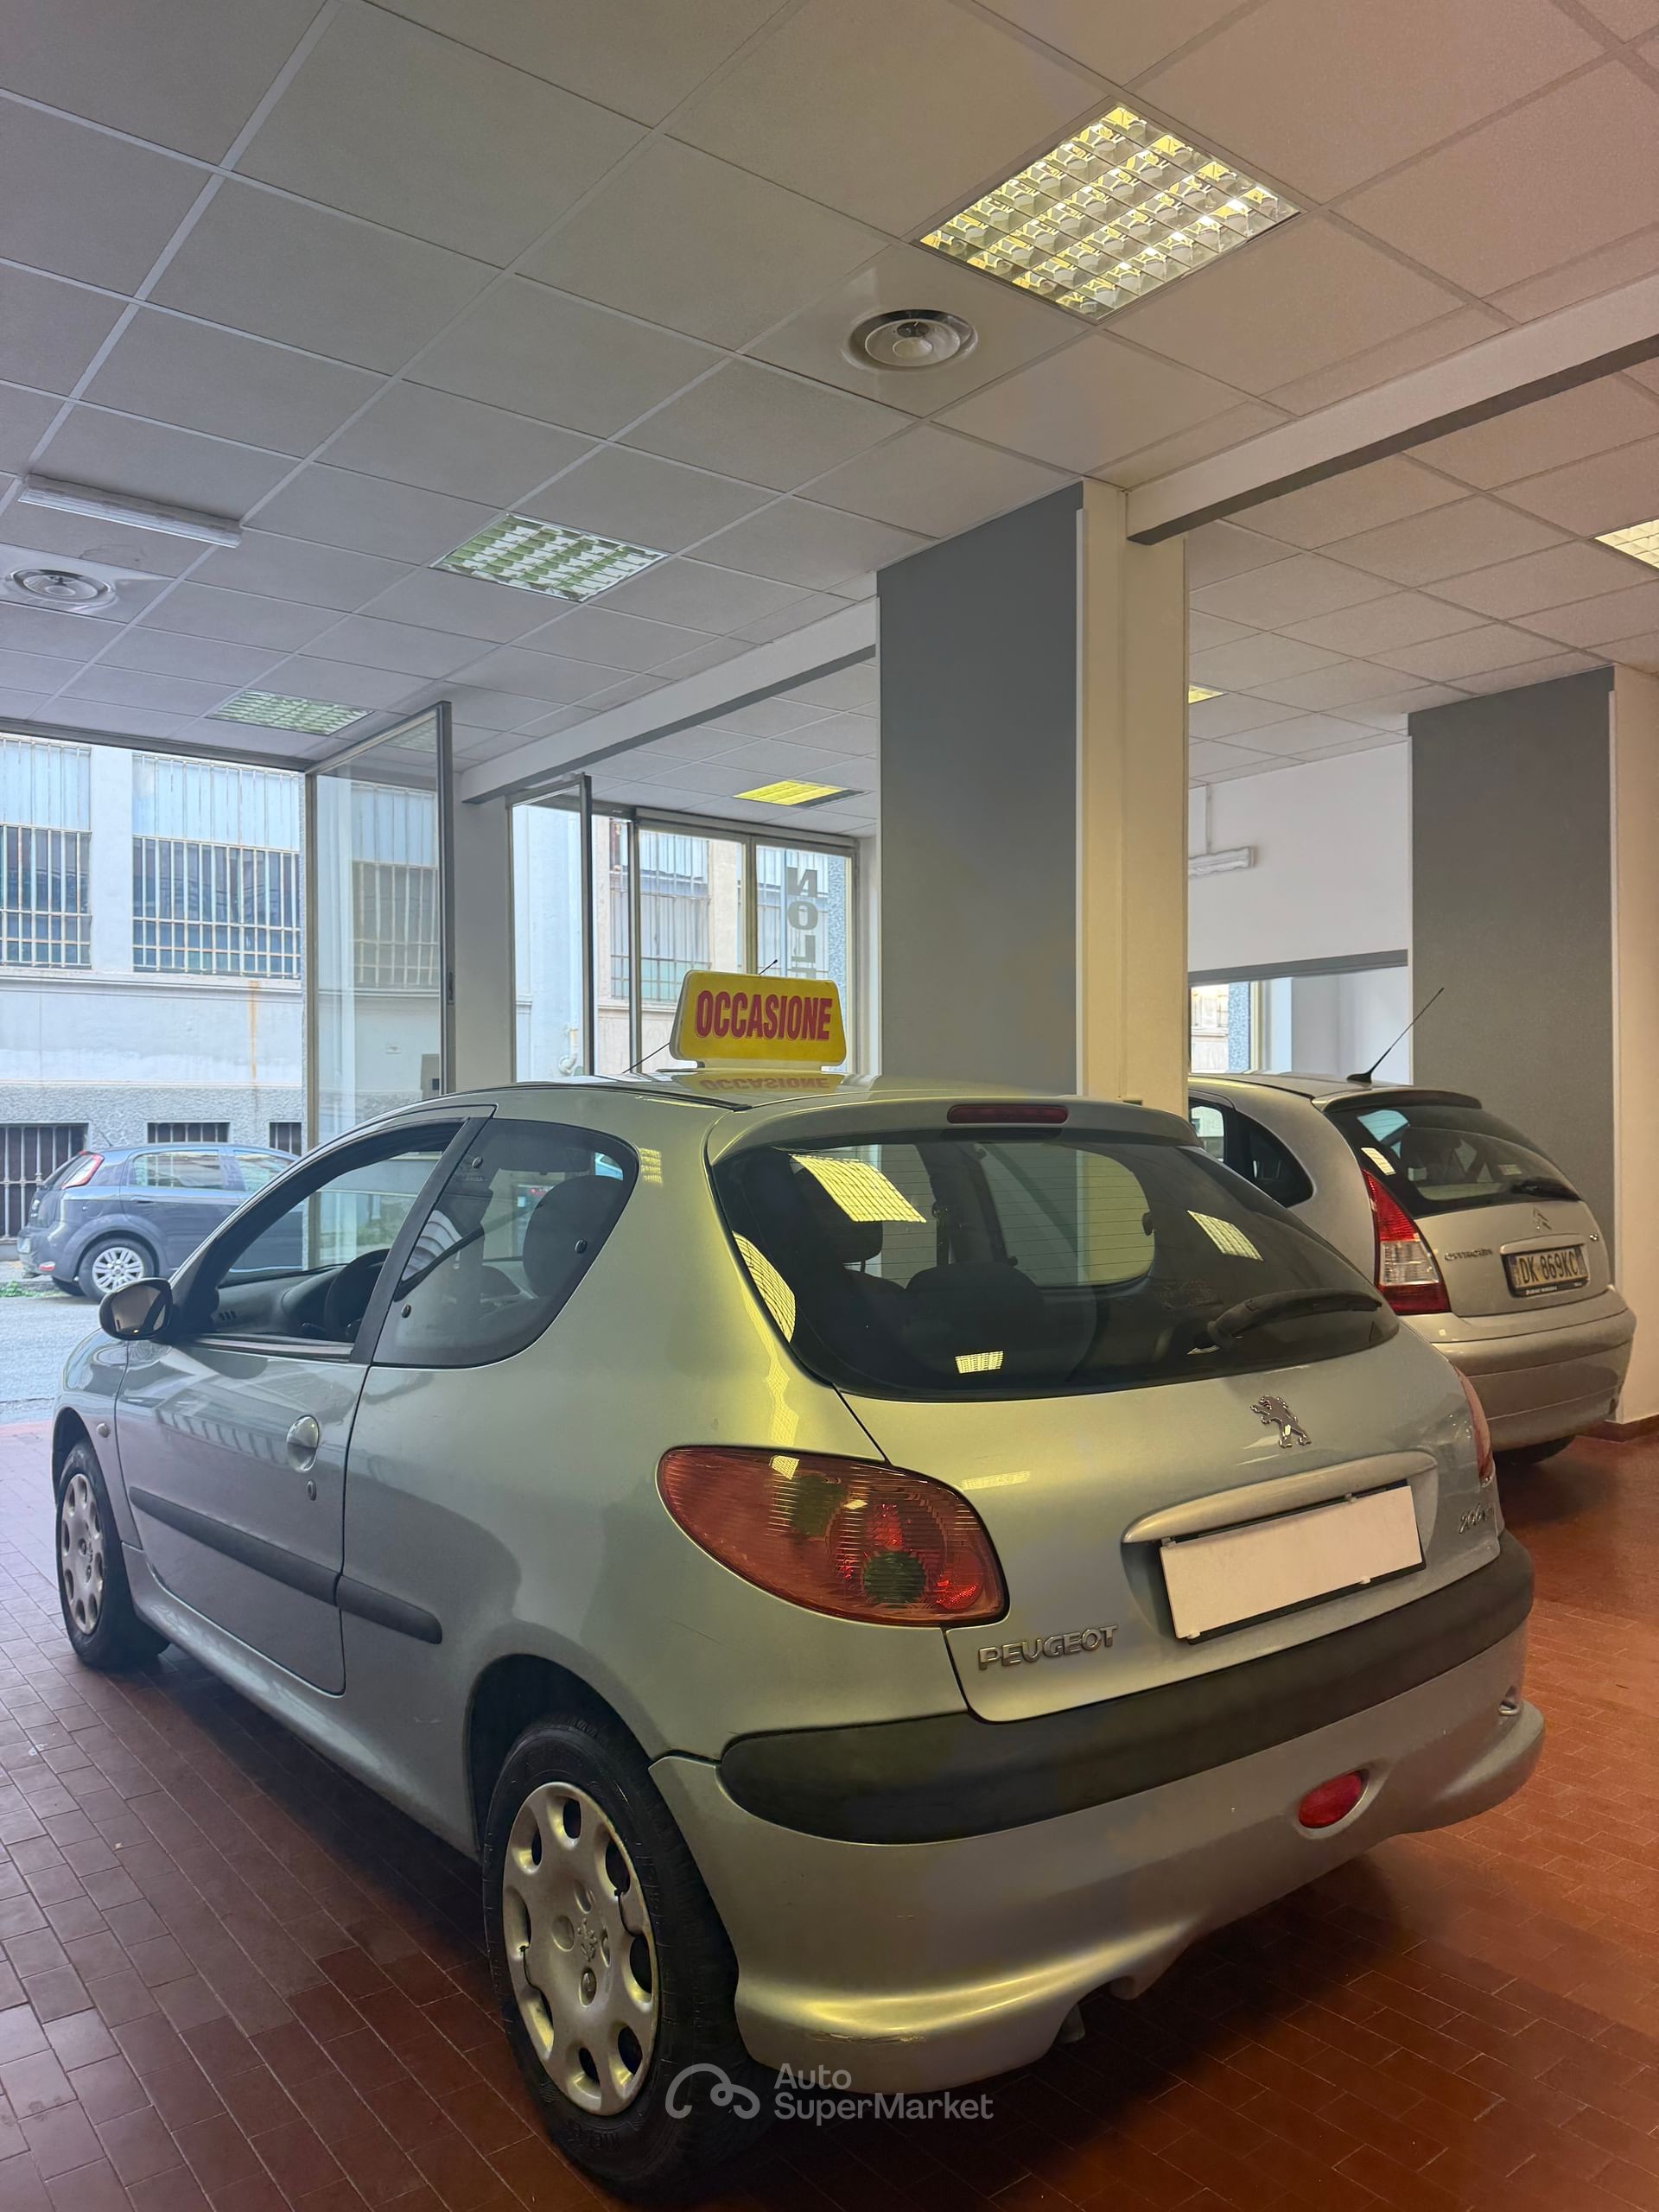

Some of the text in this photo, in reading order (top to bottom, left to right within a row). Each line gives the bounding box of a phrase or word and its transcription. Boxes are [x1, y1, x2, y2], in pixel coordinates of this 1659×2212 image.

[695, 990, 833, 1041] OCCASIONE
[1519, 1250, 1579, 1284] DK 869KC
[978, 1624, 1118, 1671] PEUGEOT
